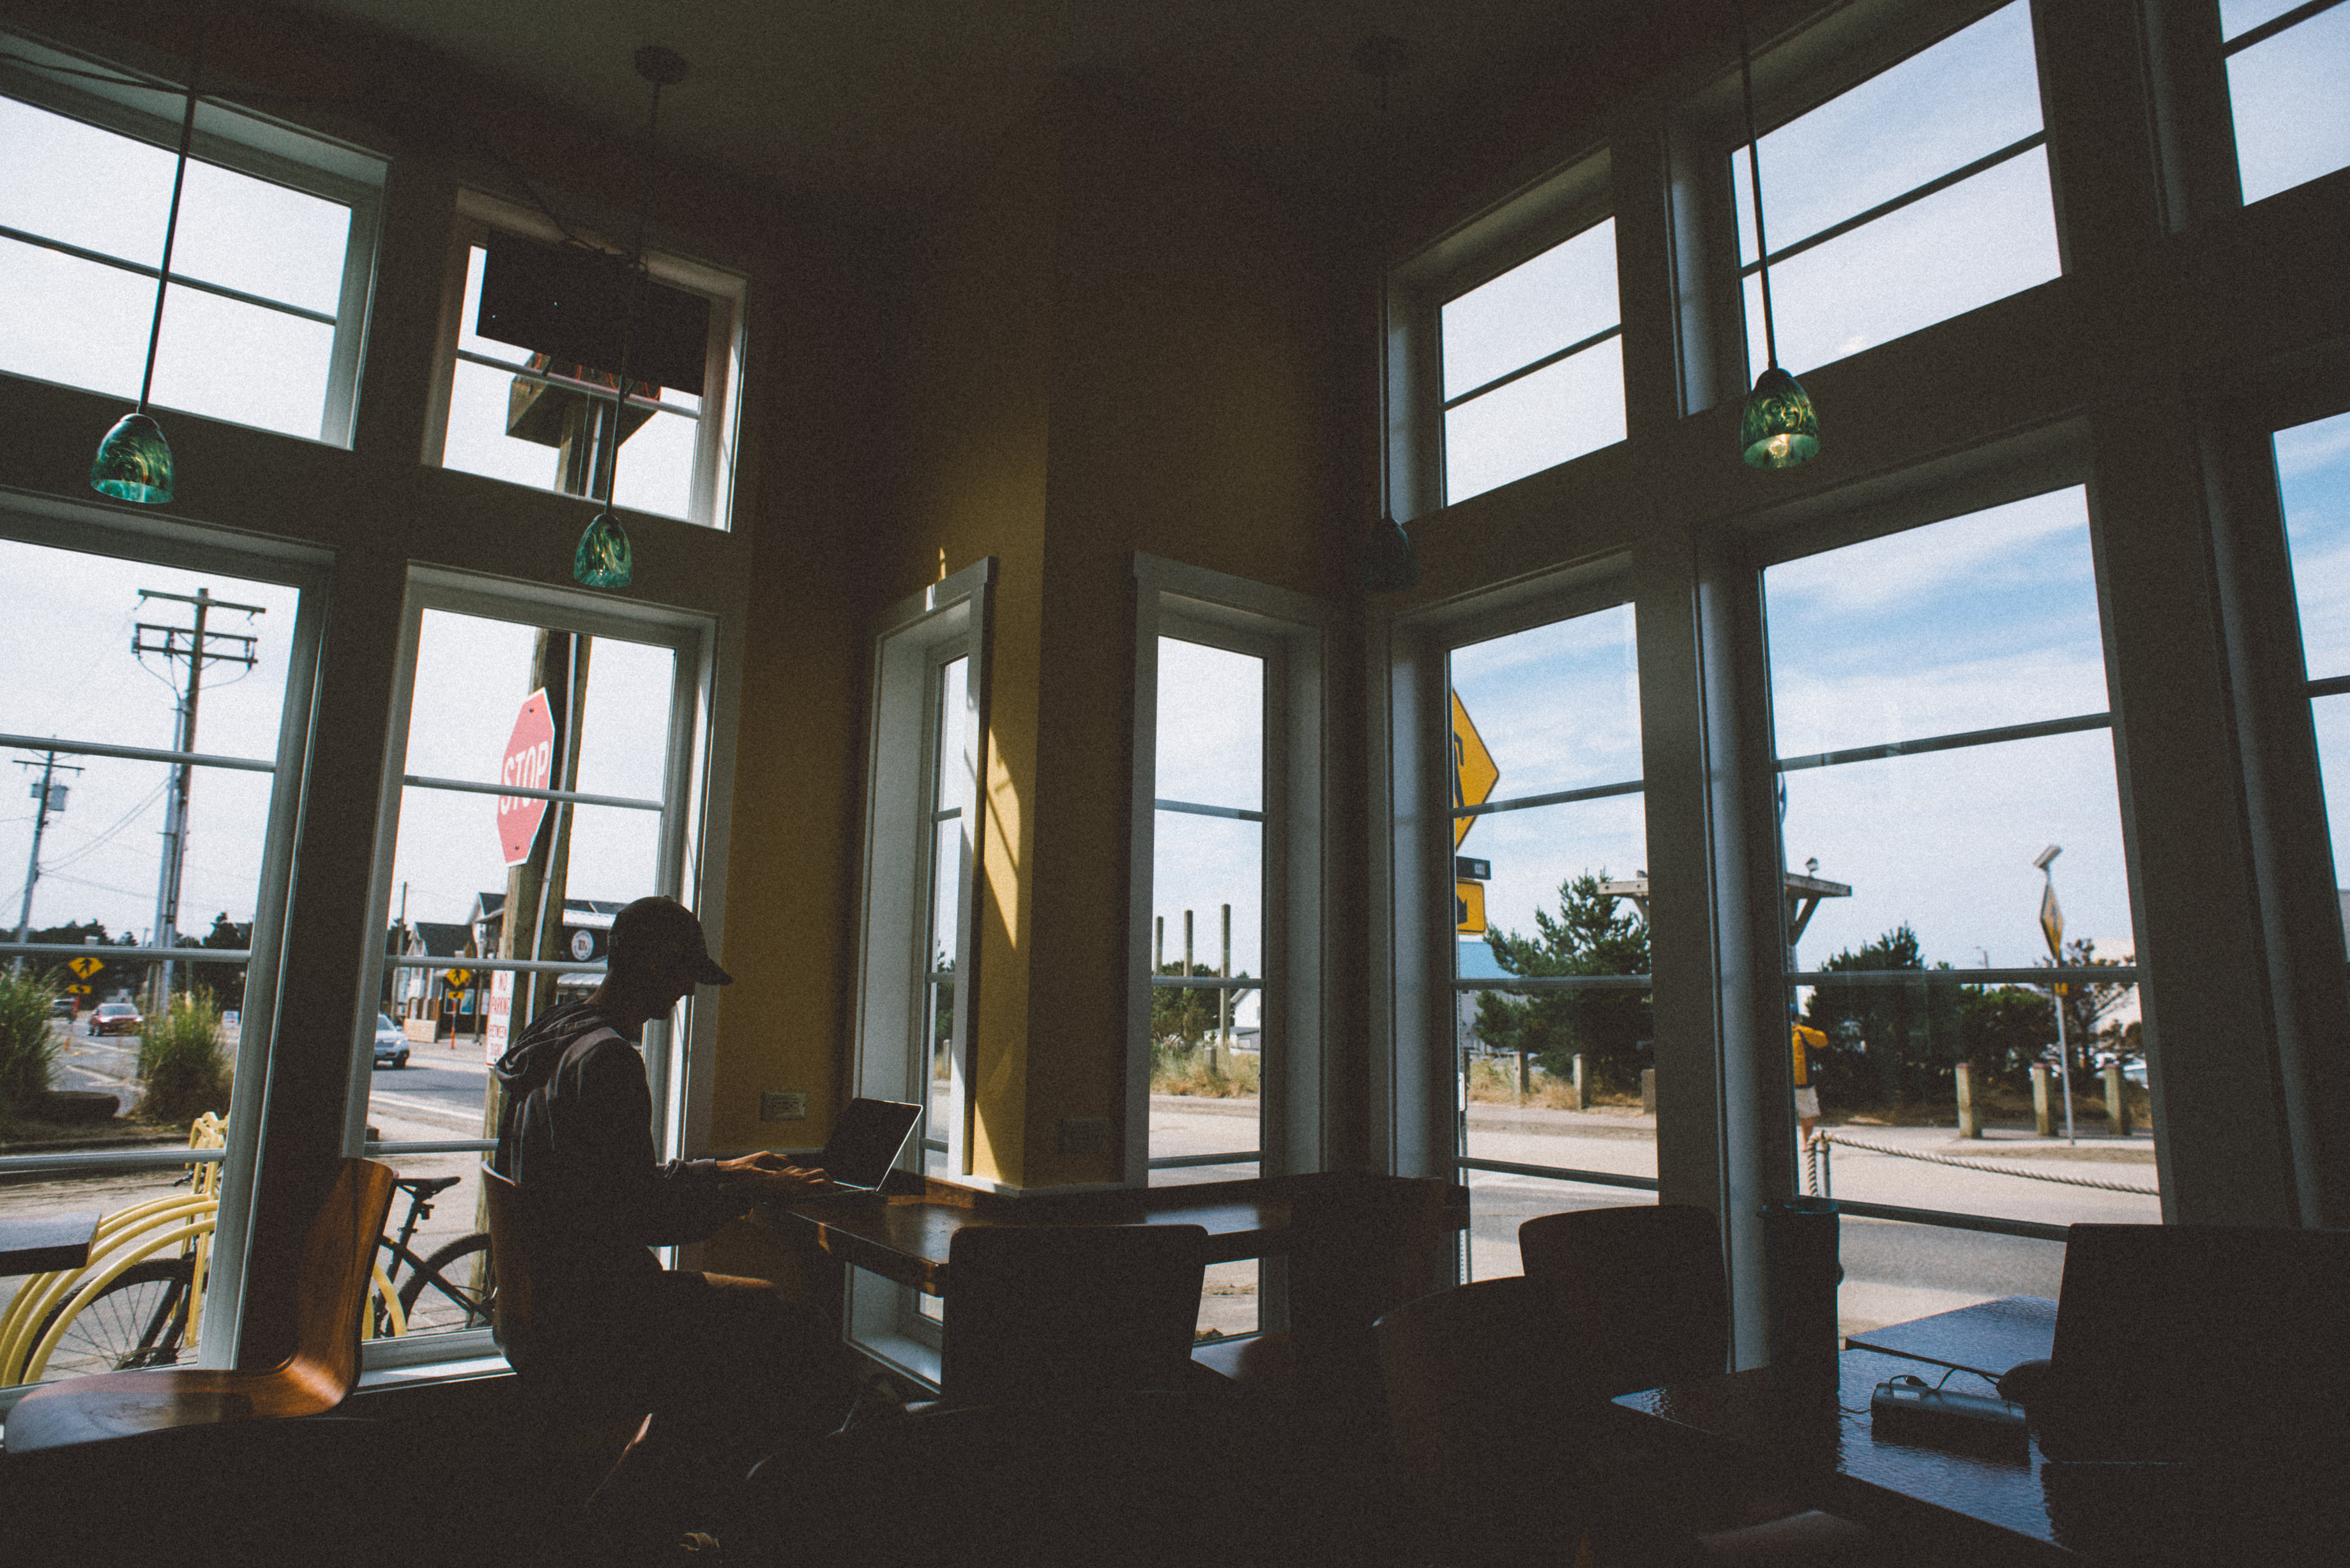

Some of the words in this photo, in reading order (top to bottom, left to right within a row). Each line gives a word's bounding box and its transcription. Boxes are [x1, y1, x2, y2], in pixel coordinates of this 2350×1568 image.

[501, 741, 549, 815] STOP
[499, 972, 508, 991] NO
[491, 995, 511, 1016] PARKING
[489, 1024, 507, 1039] BETWEEN
